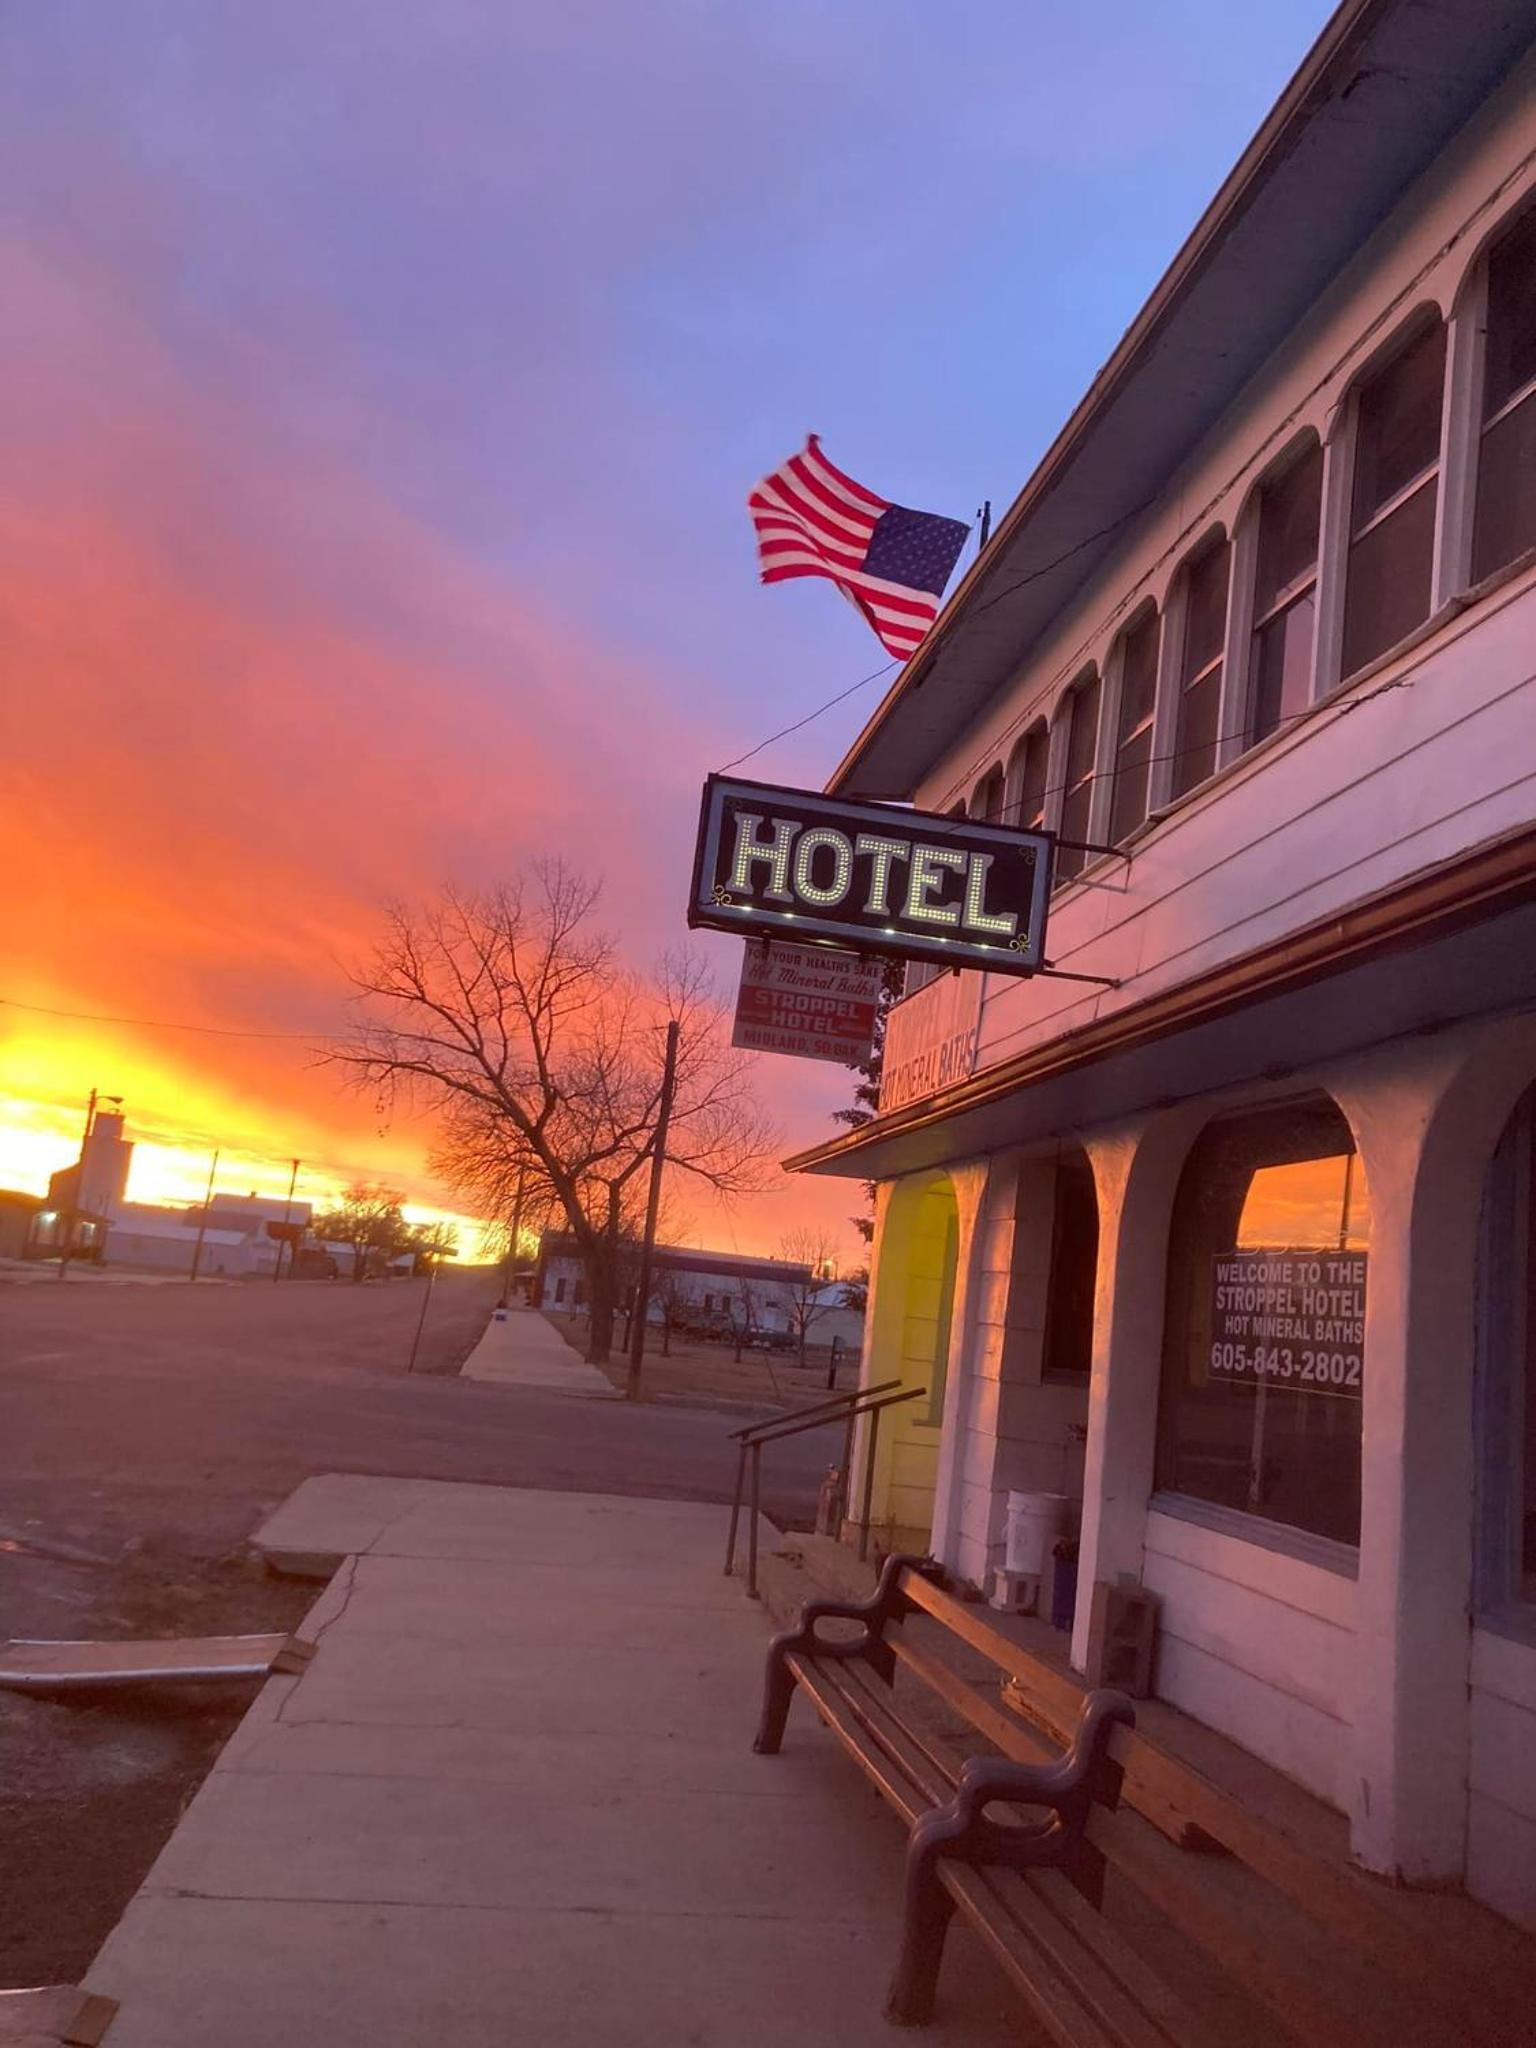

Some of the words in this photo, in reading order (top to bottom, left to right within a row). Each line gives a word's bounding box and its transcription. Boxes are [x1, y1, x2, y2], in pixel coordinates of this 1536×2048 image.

[726, 812, 1018, 935] HOTEL
[773, 951, 802, 966] YOUR
[854, 962, 879, 978] SAKE
[777, 968, 835, 991] Mineral
[836, 977, 876, 997] Baths
[755, 990, 859, 1018] STROPPEL
[770, 1010, 838, 1033] HOTEL
[898, 1048, 936, 1103] MINERAL
[938, 1027, 976, 1087] BATHS
[1217, 1262, 1292, 1283] WELCOME
[1298, 1262, 1321, 1283] TO
[1327, 1262, 1364, 1283] THE
[1216, 1286, 1296, 1314] STROPPEL
[1302, 1289, 1364, 1317] HOTEL
[1225, 1315, 1250, 1335] HOT
[1252, 1316, 1311, 1340] MINERAL
[1315, 1320, 1364, 1344] BATHS
[1211, 1342, 1361, 1385] 605-843-2802
